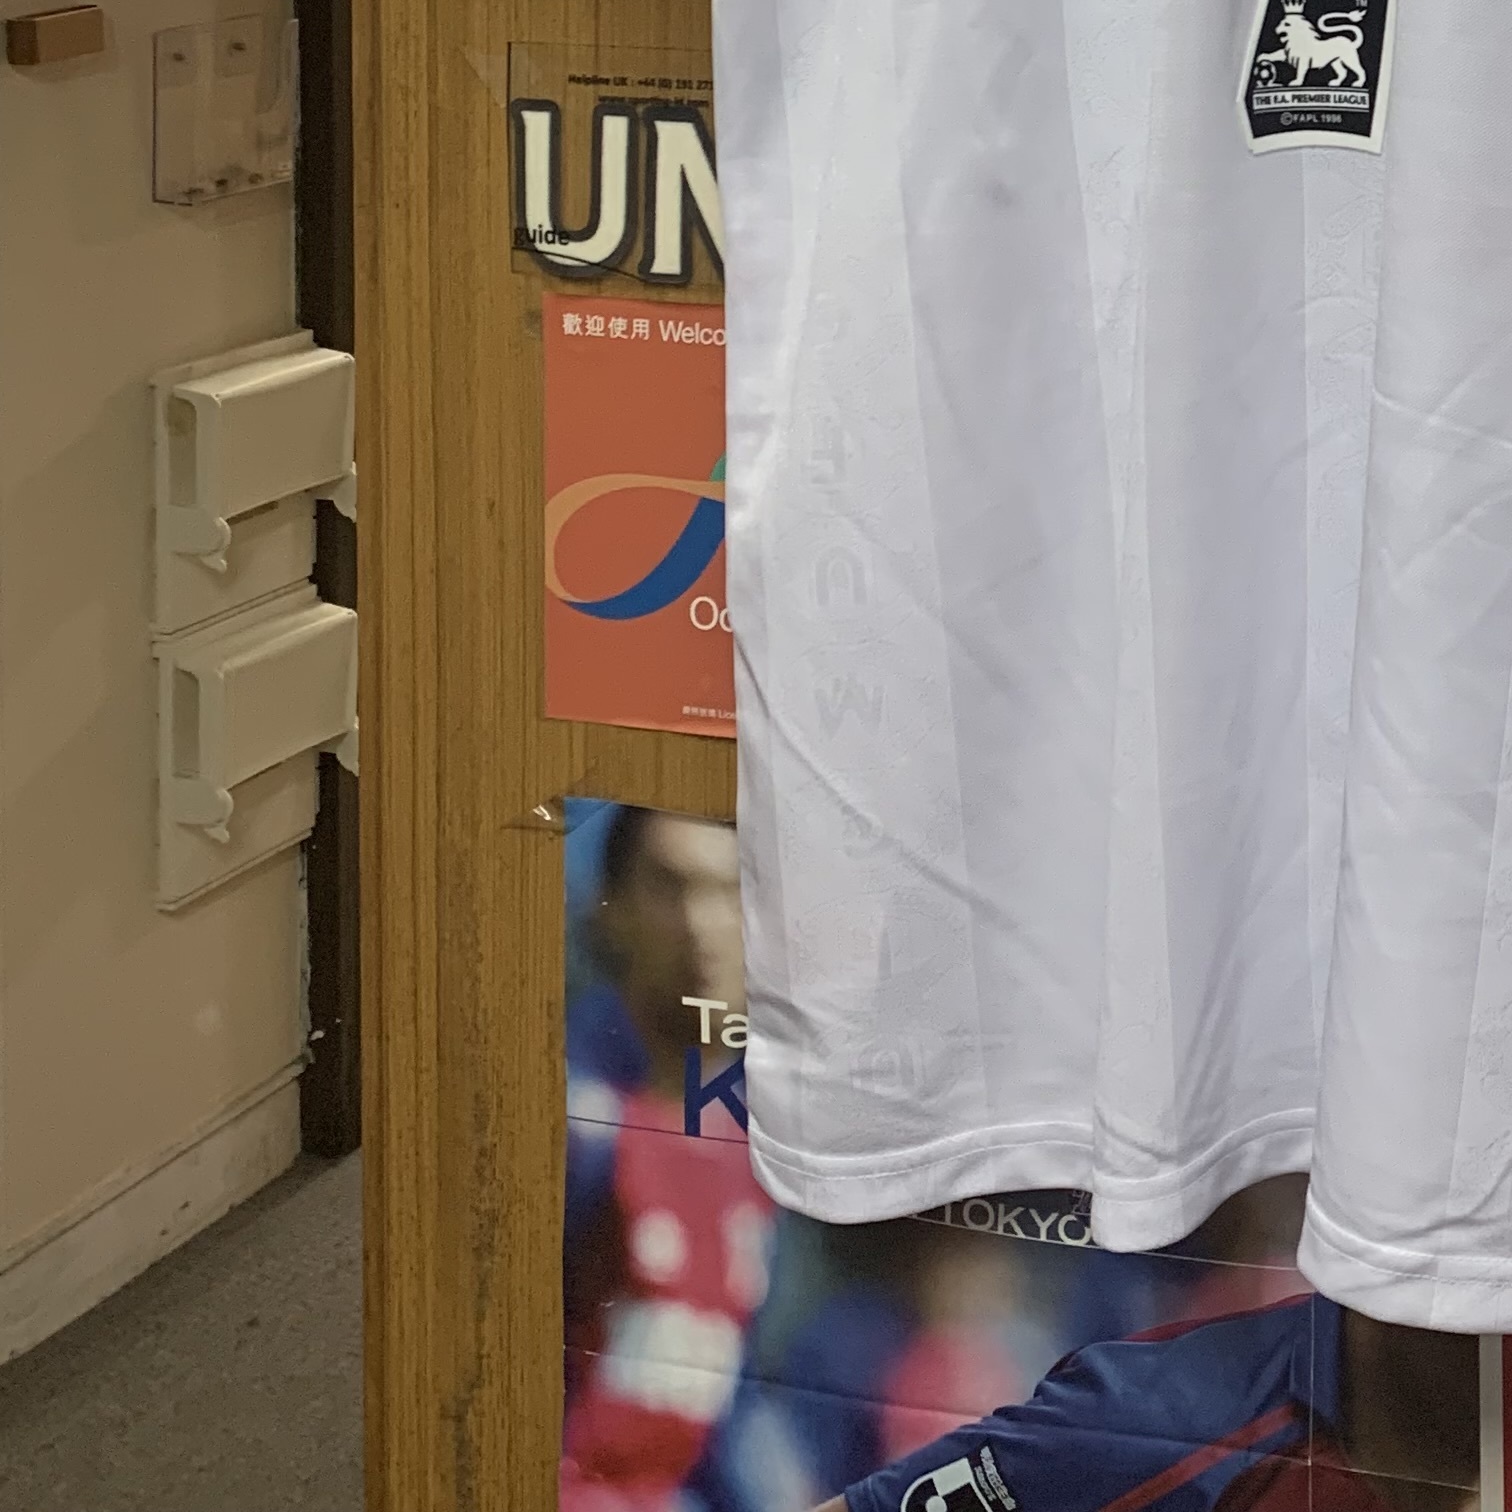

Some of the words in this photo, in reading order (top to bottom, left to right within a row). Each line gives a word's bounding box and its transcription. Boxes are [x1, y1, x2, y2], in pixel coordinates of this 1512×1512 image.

[1255, 95, 1272, 105] THE
[1291, 94, 1332, 104] PREMIER
[1333, 94, 1368, 105] LEAGUE
[562, 313, 650, 340] 歡迎使用
